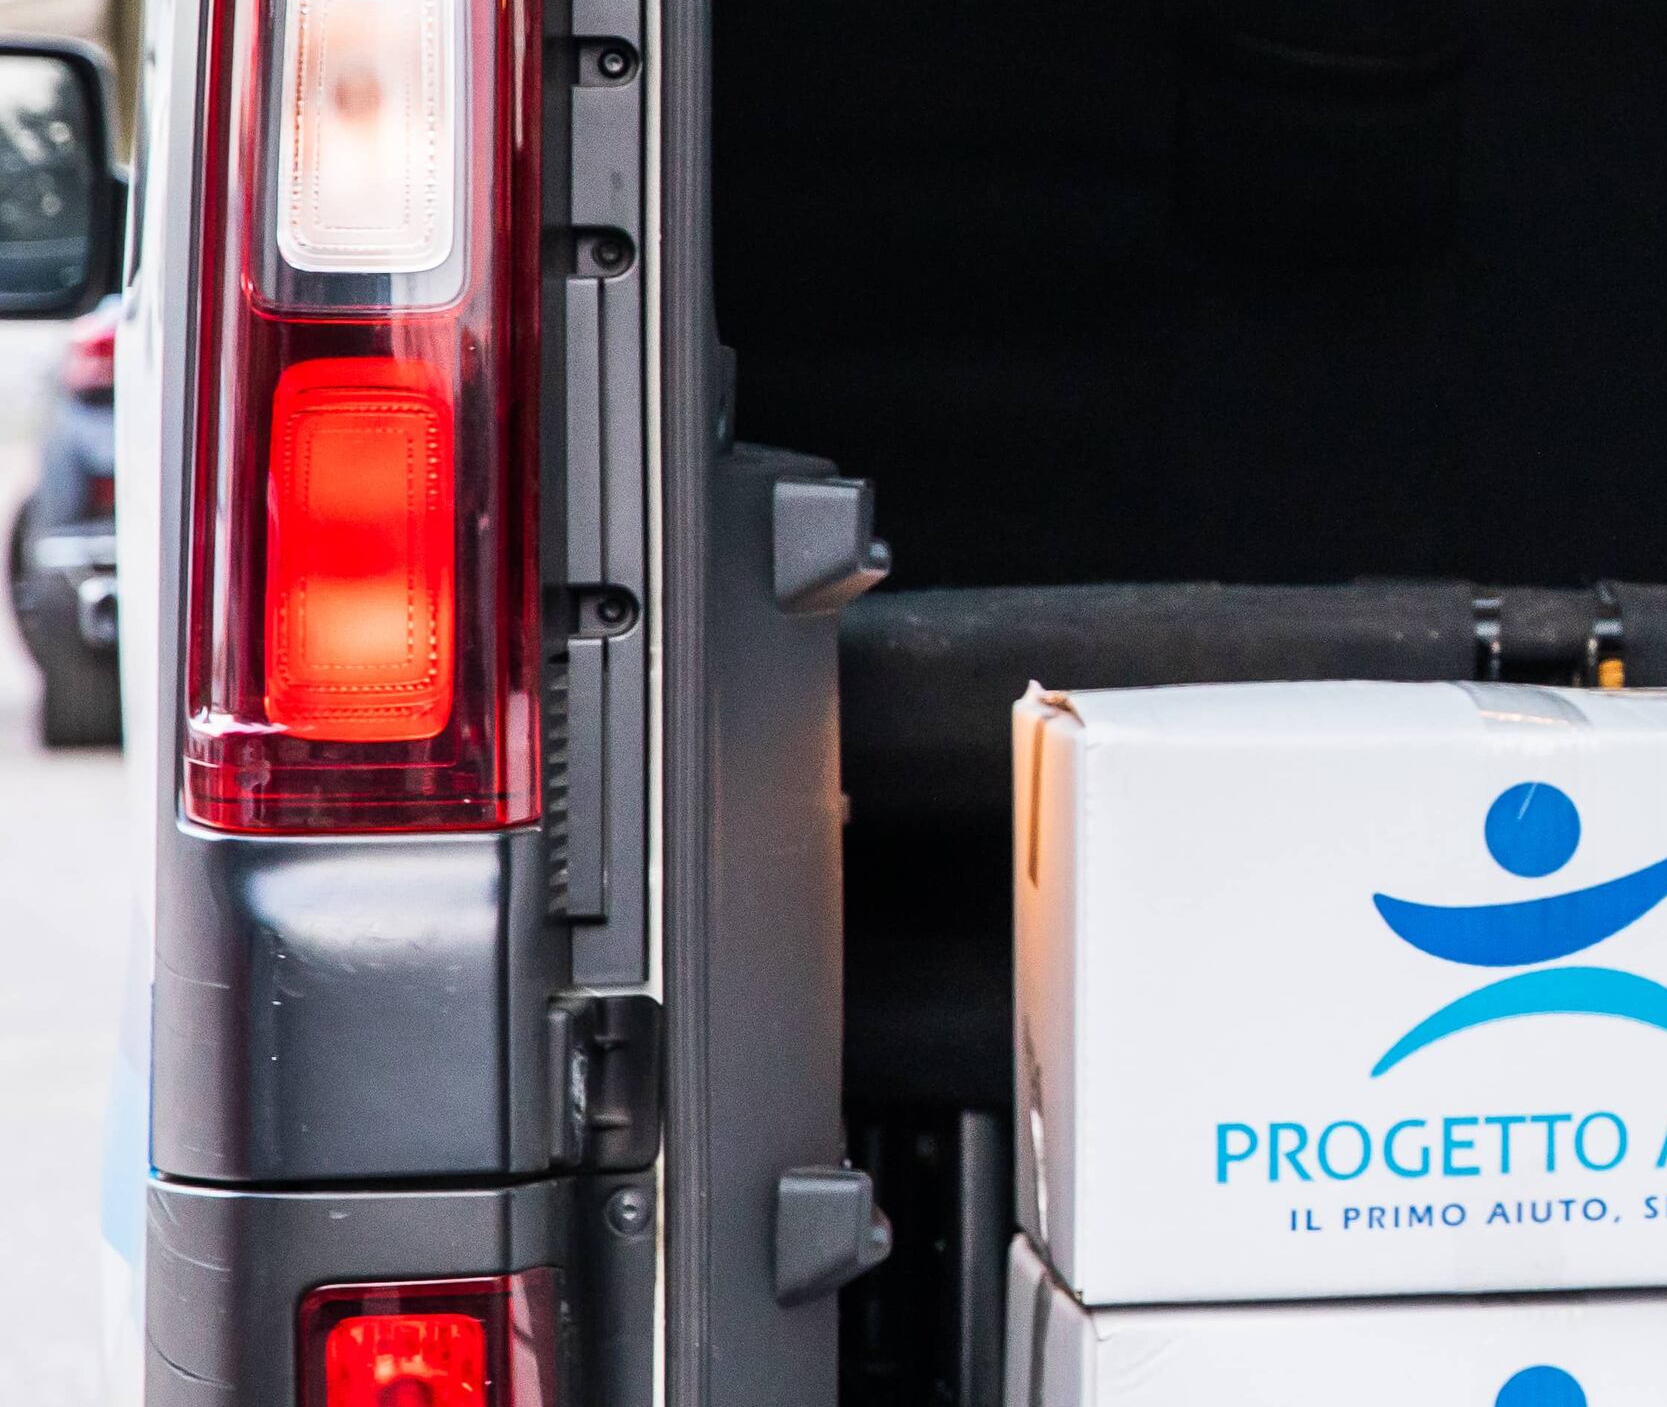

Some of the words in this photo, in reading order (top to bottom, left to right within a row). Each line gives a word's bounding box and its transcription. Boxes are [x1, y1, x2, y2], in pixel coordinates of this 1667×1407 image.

[1216, 1111, 1629, 1185] PROGETTO
[1290, 1208, 1320, 1232] IL
[1343, 1203, 1467, 1230] PRIMO
[1487, 1197, 1622, 1226] AIUTO,
